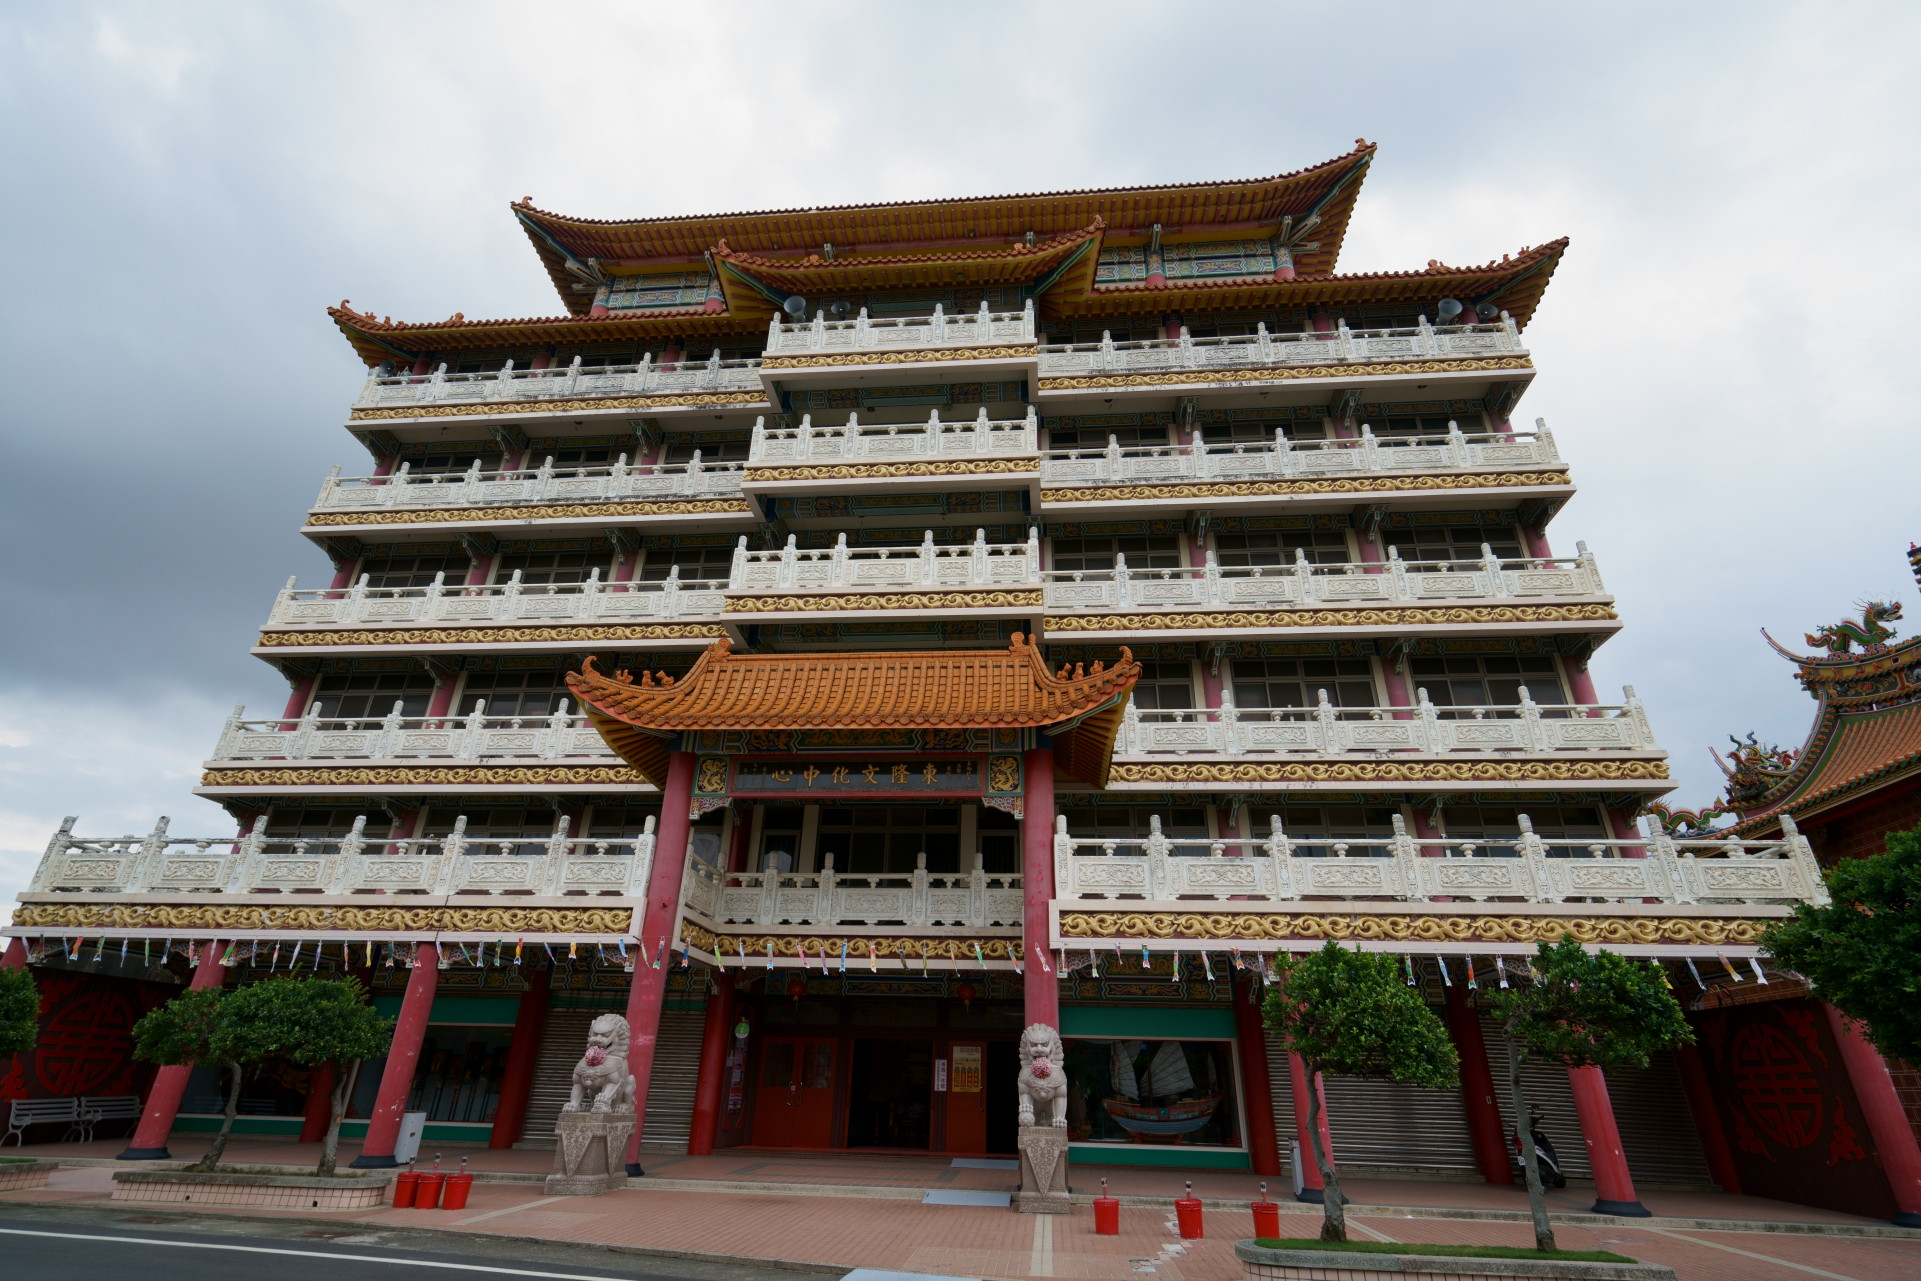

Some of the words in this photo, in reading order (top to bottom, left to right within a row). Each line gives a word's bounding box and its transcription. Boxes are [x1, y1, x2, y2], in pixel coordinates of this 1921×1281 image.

[771, 763, 939, 787] 東隆文化中心
